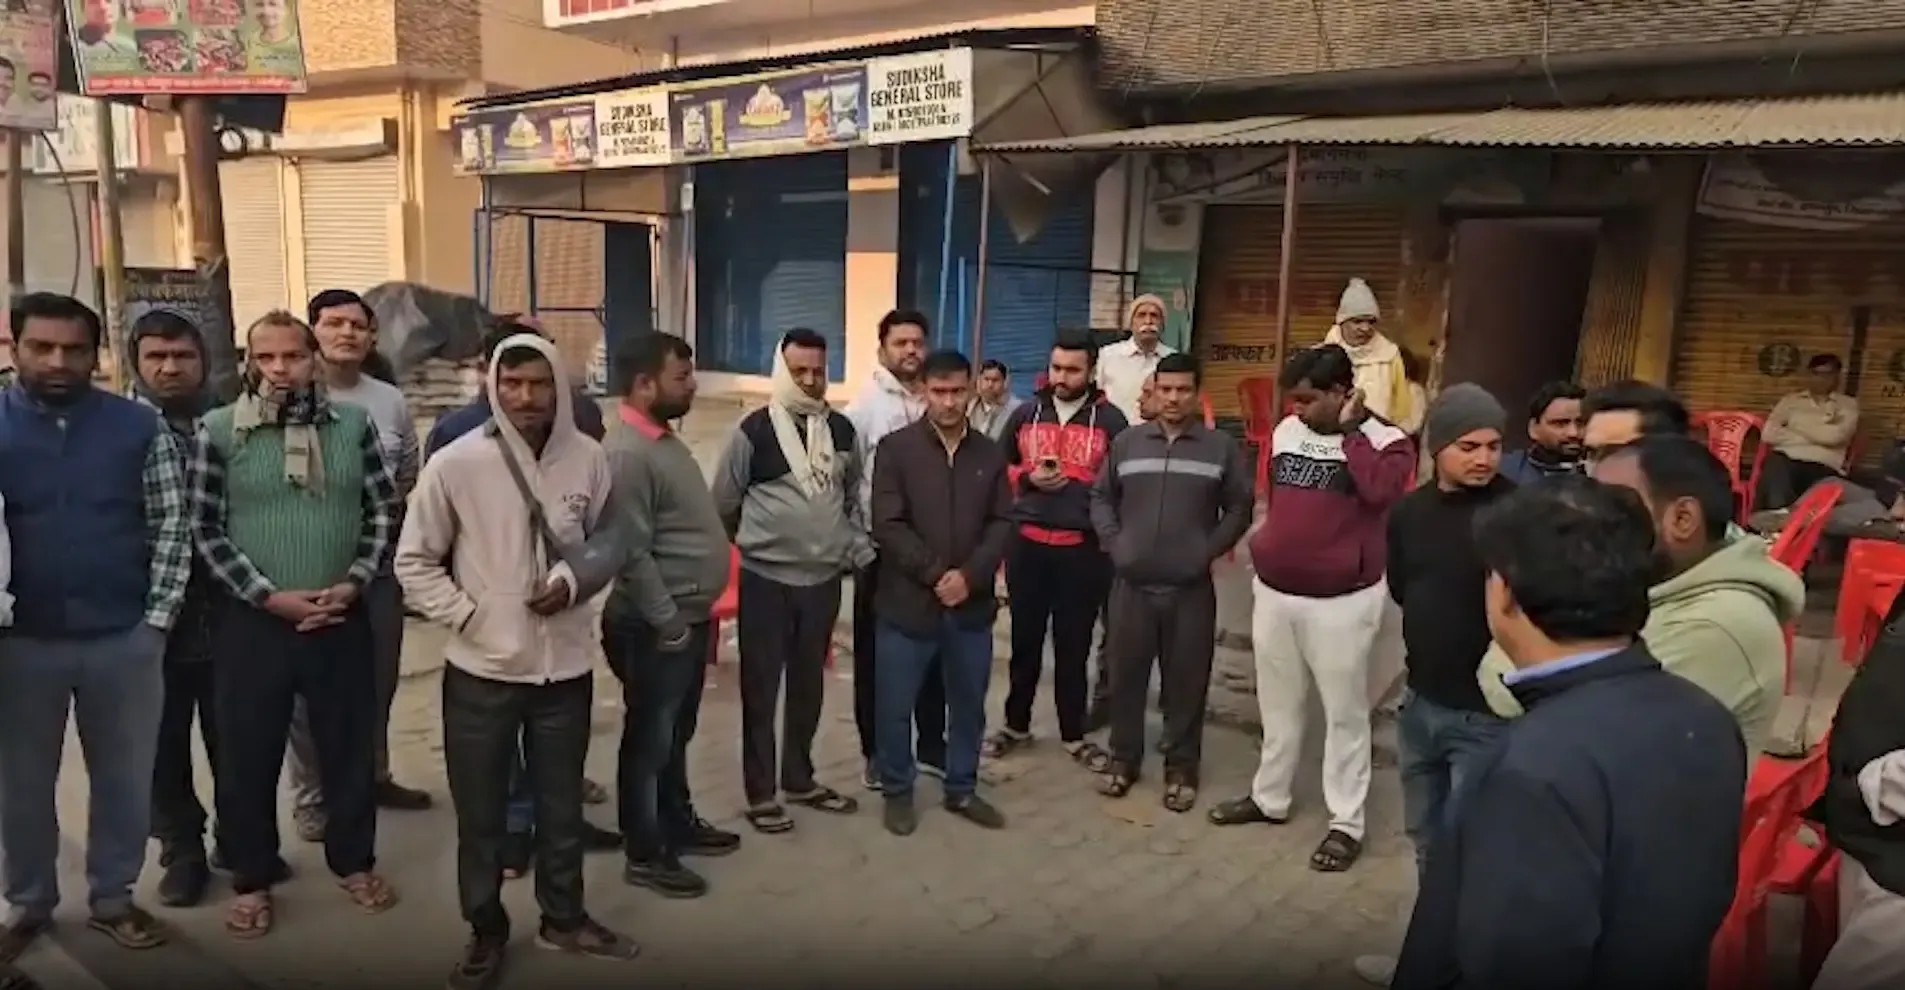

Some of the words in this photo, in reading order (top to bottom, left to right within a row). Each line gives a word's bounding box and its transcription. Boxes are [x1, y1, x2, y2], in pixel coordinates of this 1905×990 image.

[886, 63, 946, 88] SUDIKSHA
[871, 85, 920, 107] GENERAL
[925, 80, 962, 100] STORE
